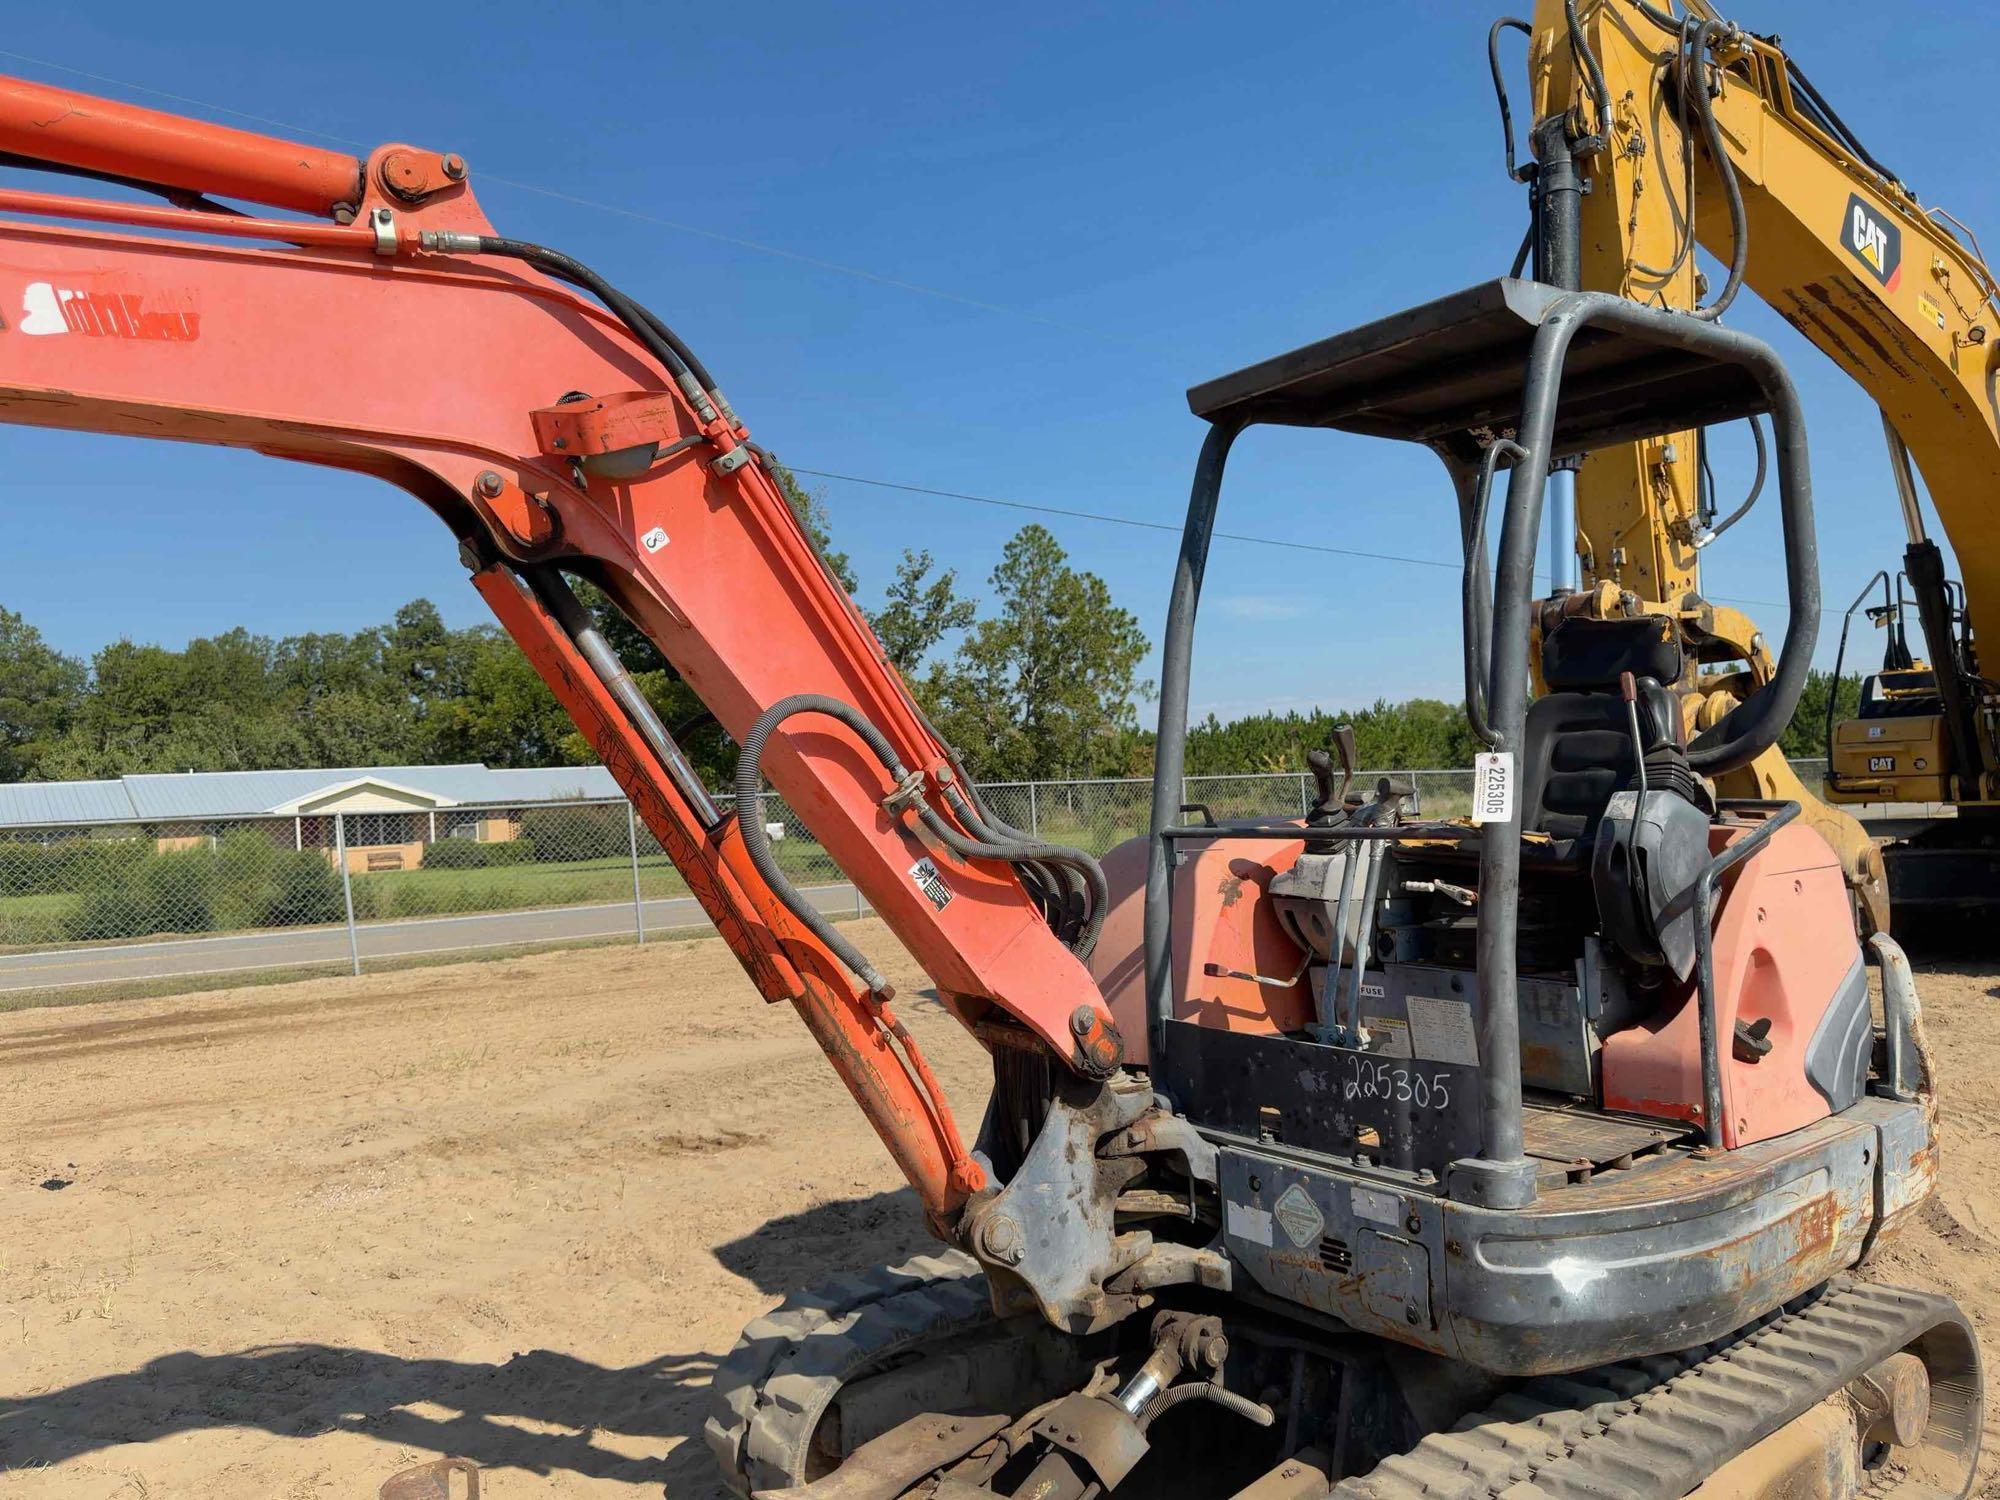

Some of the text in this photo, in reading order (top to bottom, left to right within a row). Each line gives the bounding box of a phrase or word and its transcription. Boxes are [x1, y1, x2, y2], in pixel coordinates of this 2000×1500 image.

[1853, 205, 1888, 275] CAT
[1871, 758, 1893, 772] CAT
[1487, 768, 1506, 814] 225305
[1361, 986, 1383, 996] FUSE
[1346, 1056, 1451, 1109] 225305
